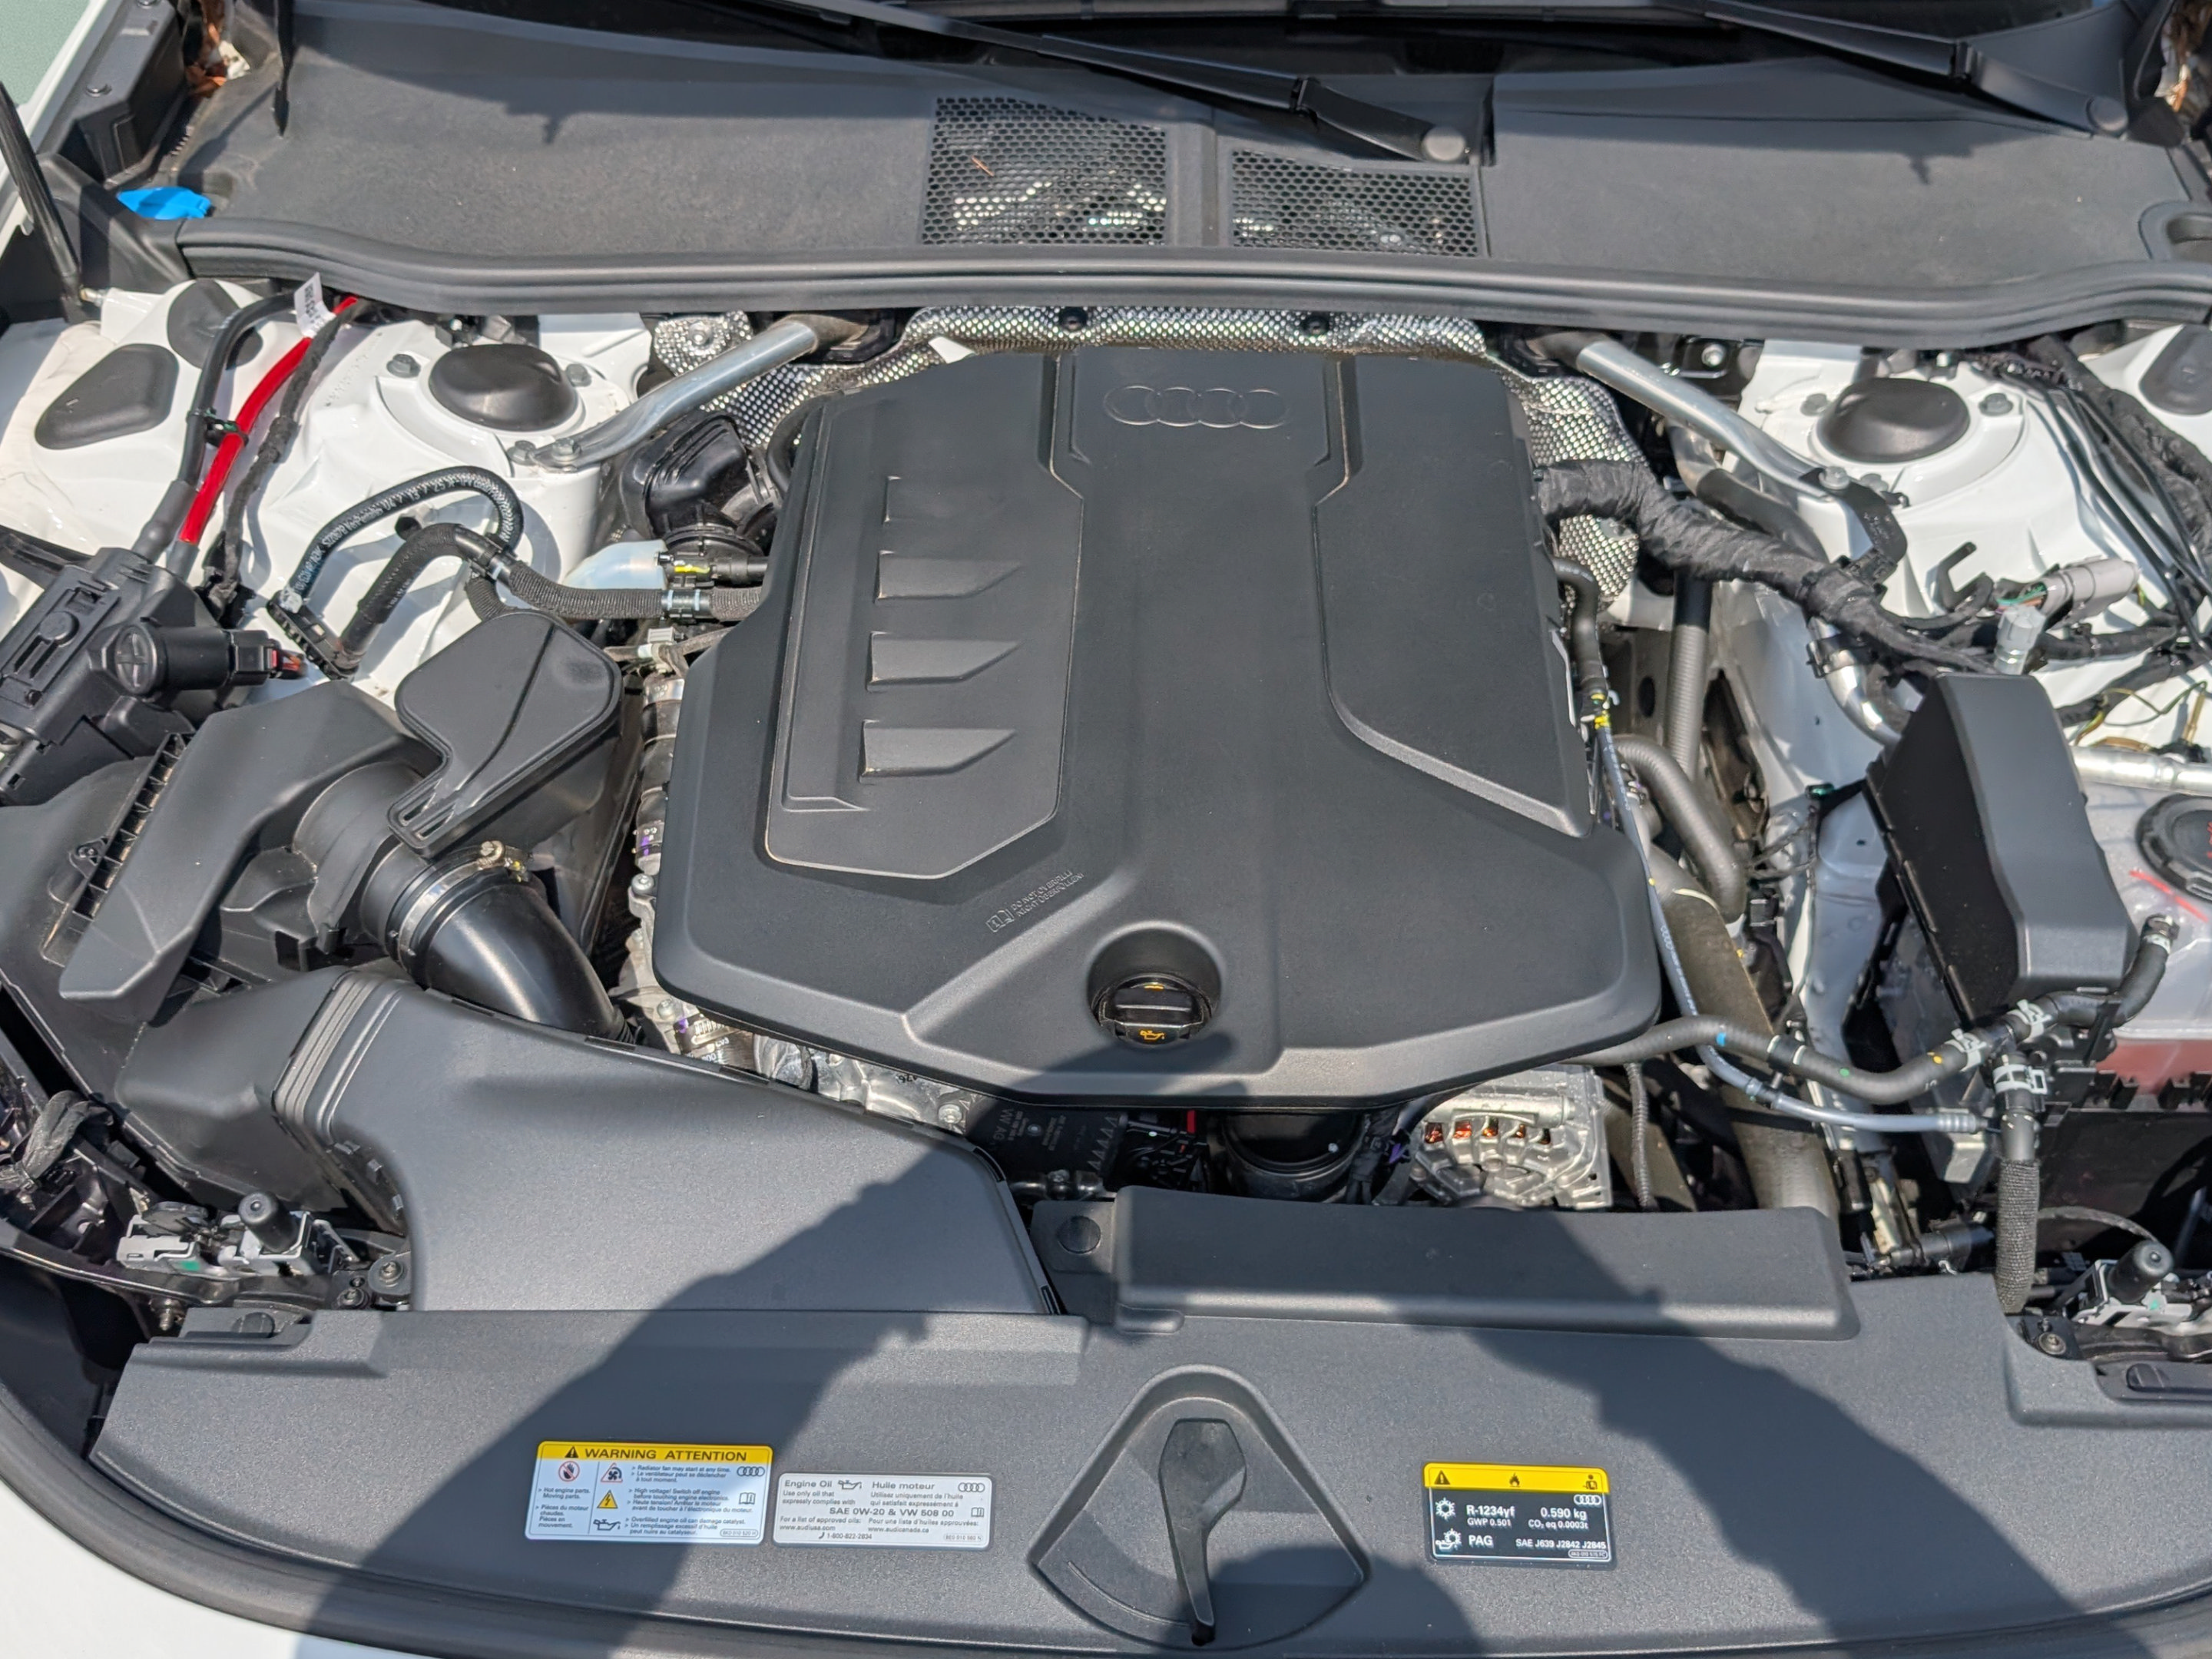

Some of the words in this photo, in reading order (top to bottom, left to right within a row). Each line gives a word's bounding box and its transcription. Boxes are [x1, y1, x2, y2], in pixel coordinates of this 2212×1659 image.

[1011, 901, 1022, 910] DO
[1022, 890, 1038, 904] NOT
[1017, 901, 1038, 917] NICHT
[584, 1448, 657, 1459] WARNING
[665, 1450, 747, 1461] ATTENTION
[785, 1480, 816, 1488] Engine
[1466, 1505, 1515, 1518] R-1234yf
[1540, 1507, 1571, 1518] 0.590
[1574, 1508, 1587, 1520] kg
[1467, 1518, 1488, 1526] GWP
[1490, 1518, 1511, 1527] 0.501
[1545, 1522, 1556, 1530] eq
[1558, 1521, 1588, 1529] 0.0003t
[1469, 1535, 1493, 1546] PAG
[1516, 1539, 1533, 1548] SAE
[1535, 1539, 1555, 1548] J639
[1556, 1540, 1580, 1548] J2842
[1582, 1541, 1606, 1549] J2845
